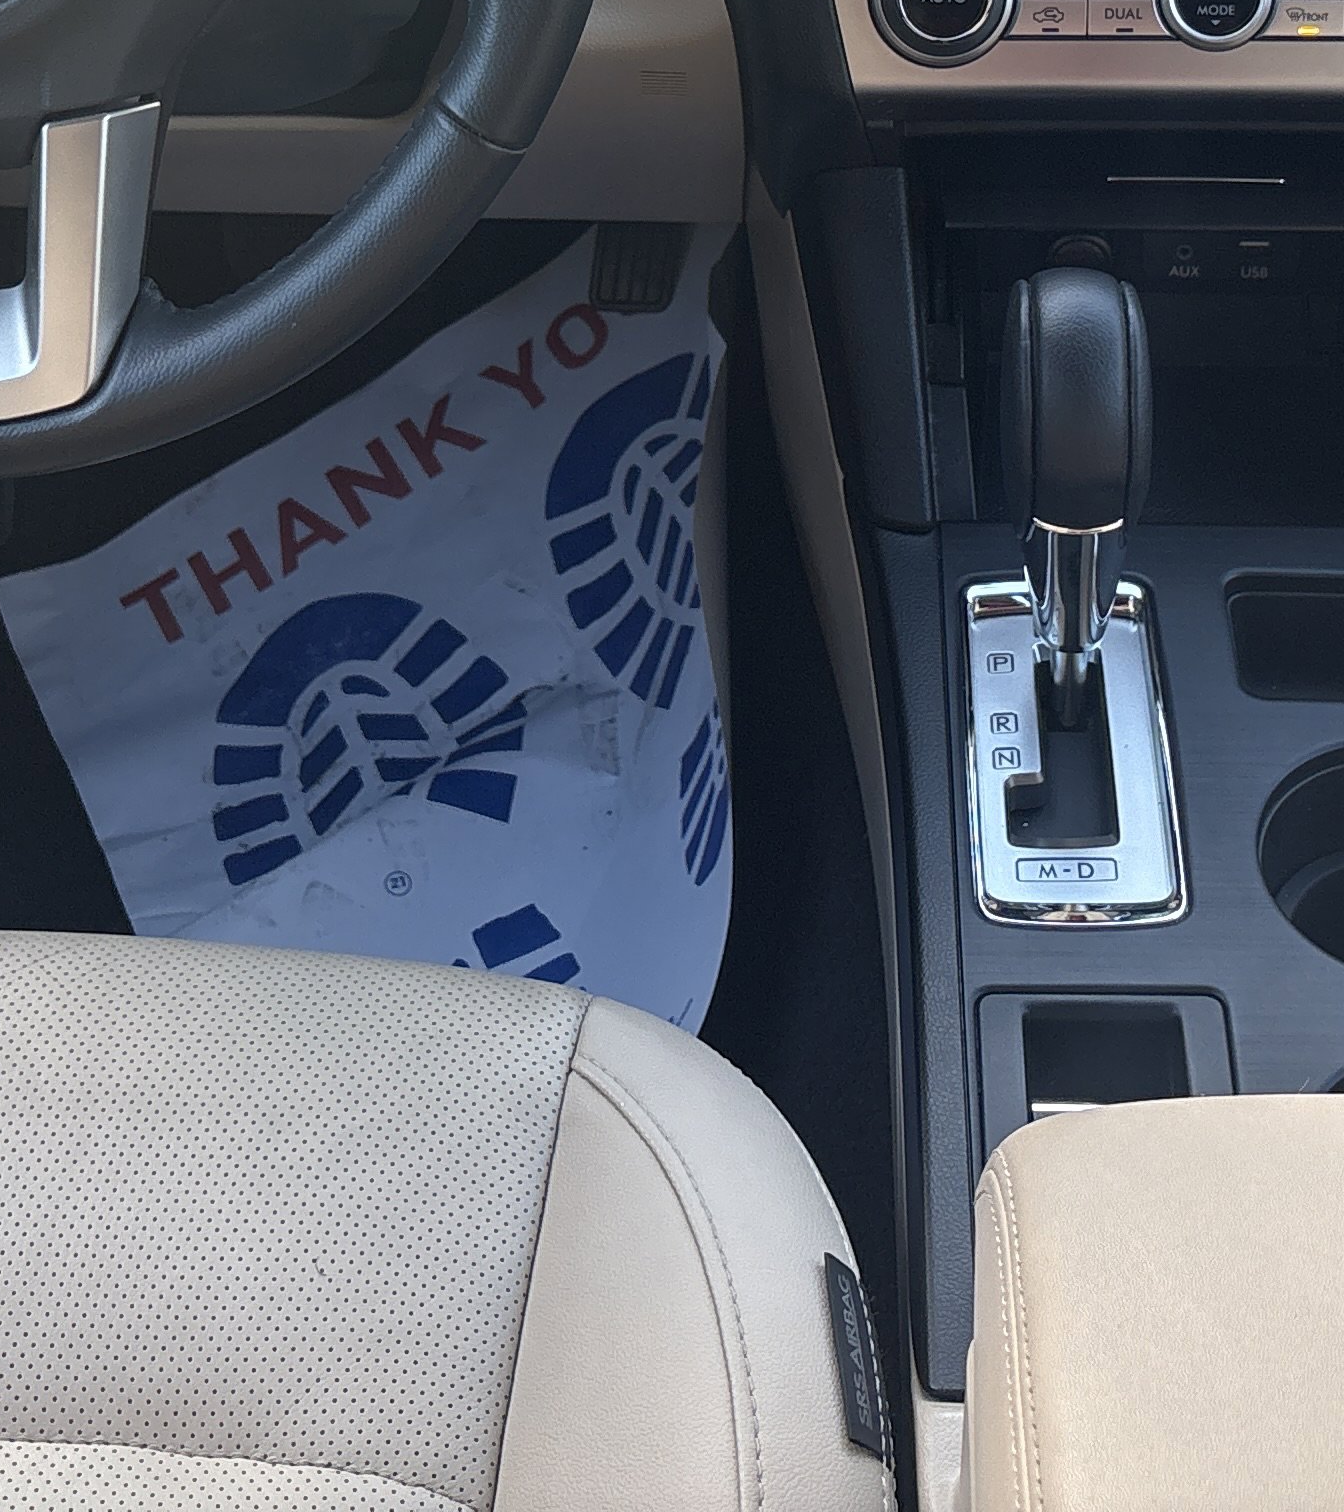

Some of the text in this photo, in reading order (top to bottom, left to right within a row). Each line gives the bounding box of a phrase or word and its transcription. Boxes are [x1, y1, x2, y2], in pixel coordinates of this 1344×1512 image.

[1104, 7, 1143, 20] DUAL
[1196, 4, 1236, 16] MODE
[1301, 12, 1329, 22] FRONT
[1168, 265, 1201, 278] AUX
[1240, 265, 1269, 279] USB
[119, 303, 608, 645] THANK YO
[993, 656, 1009, 669] P
[996, 717, 1011, 732] R
[998, 751, 1015, 765] N
[837, 1273, 874, 1431] SRS AIRBAG
